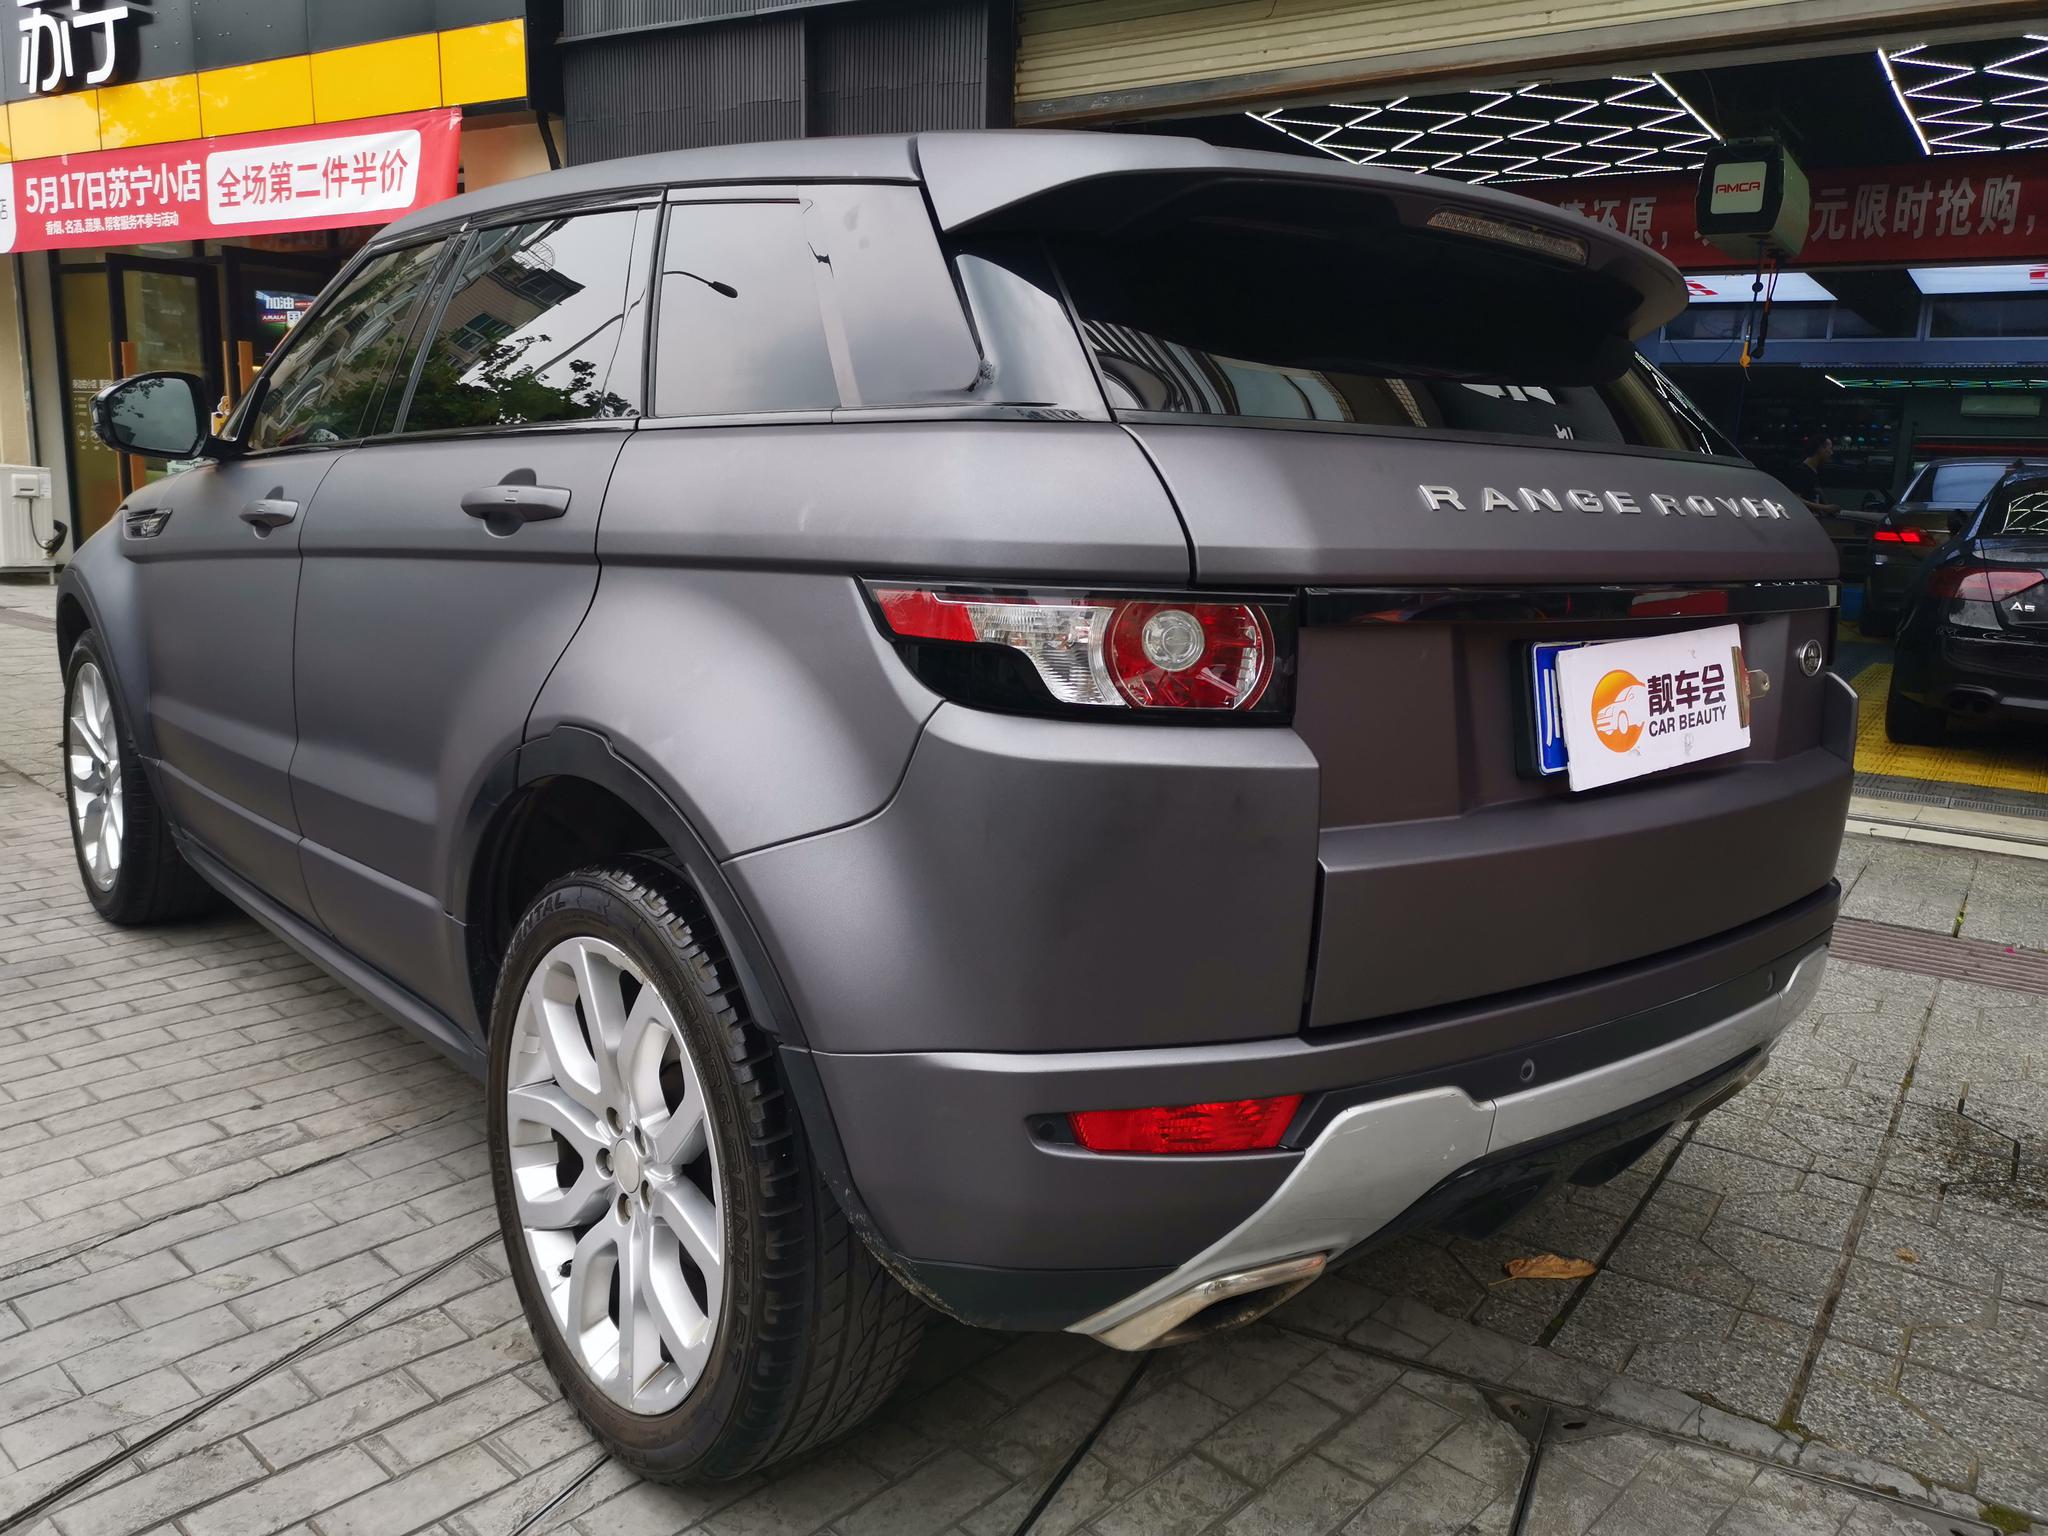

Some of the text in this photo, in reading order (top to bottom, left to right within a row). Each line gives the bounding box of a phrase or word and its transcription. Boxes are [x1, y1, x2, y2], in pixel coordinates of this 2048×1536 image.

[25, 160, 201, 214] 5月17日苏宁小店
[217, 148, 408, 208] 全场第二件半价
[1715, 181, 1761, 194] AMCA
[1419, 484, 1791, 519] RANGE ROVER
[2010, 601, 2036, 613] A5
[1647, 664, 1726, 717] 靓车会
[1648, 705, 1727, 737] CAR BEAUTY
